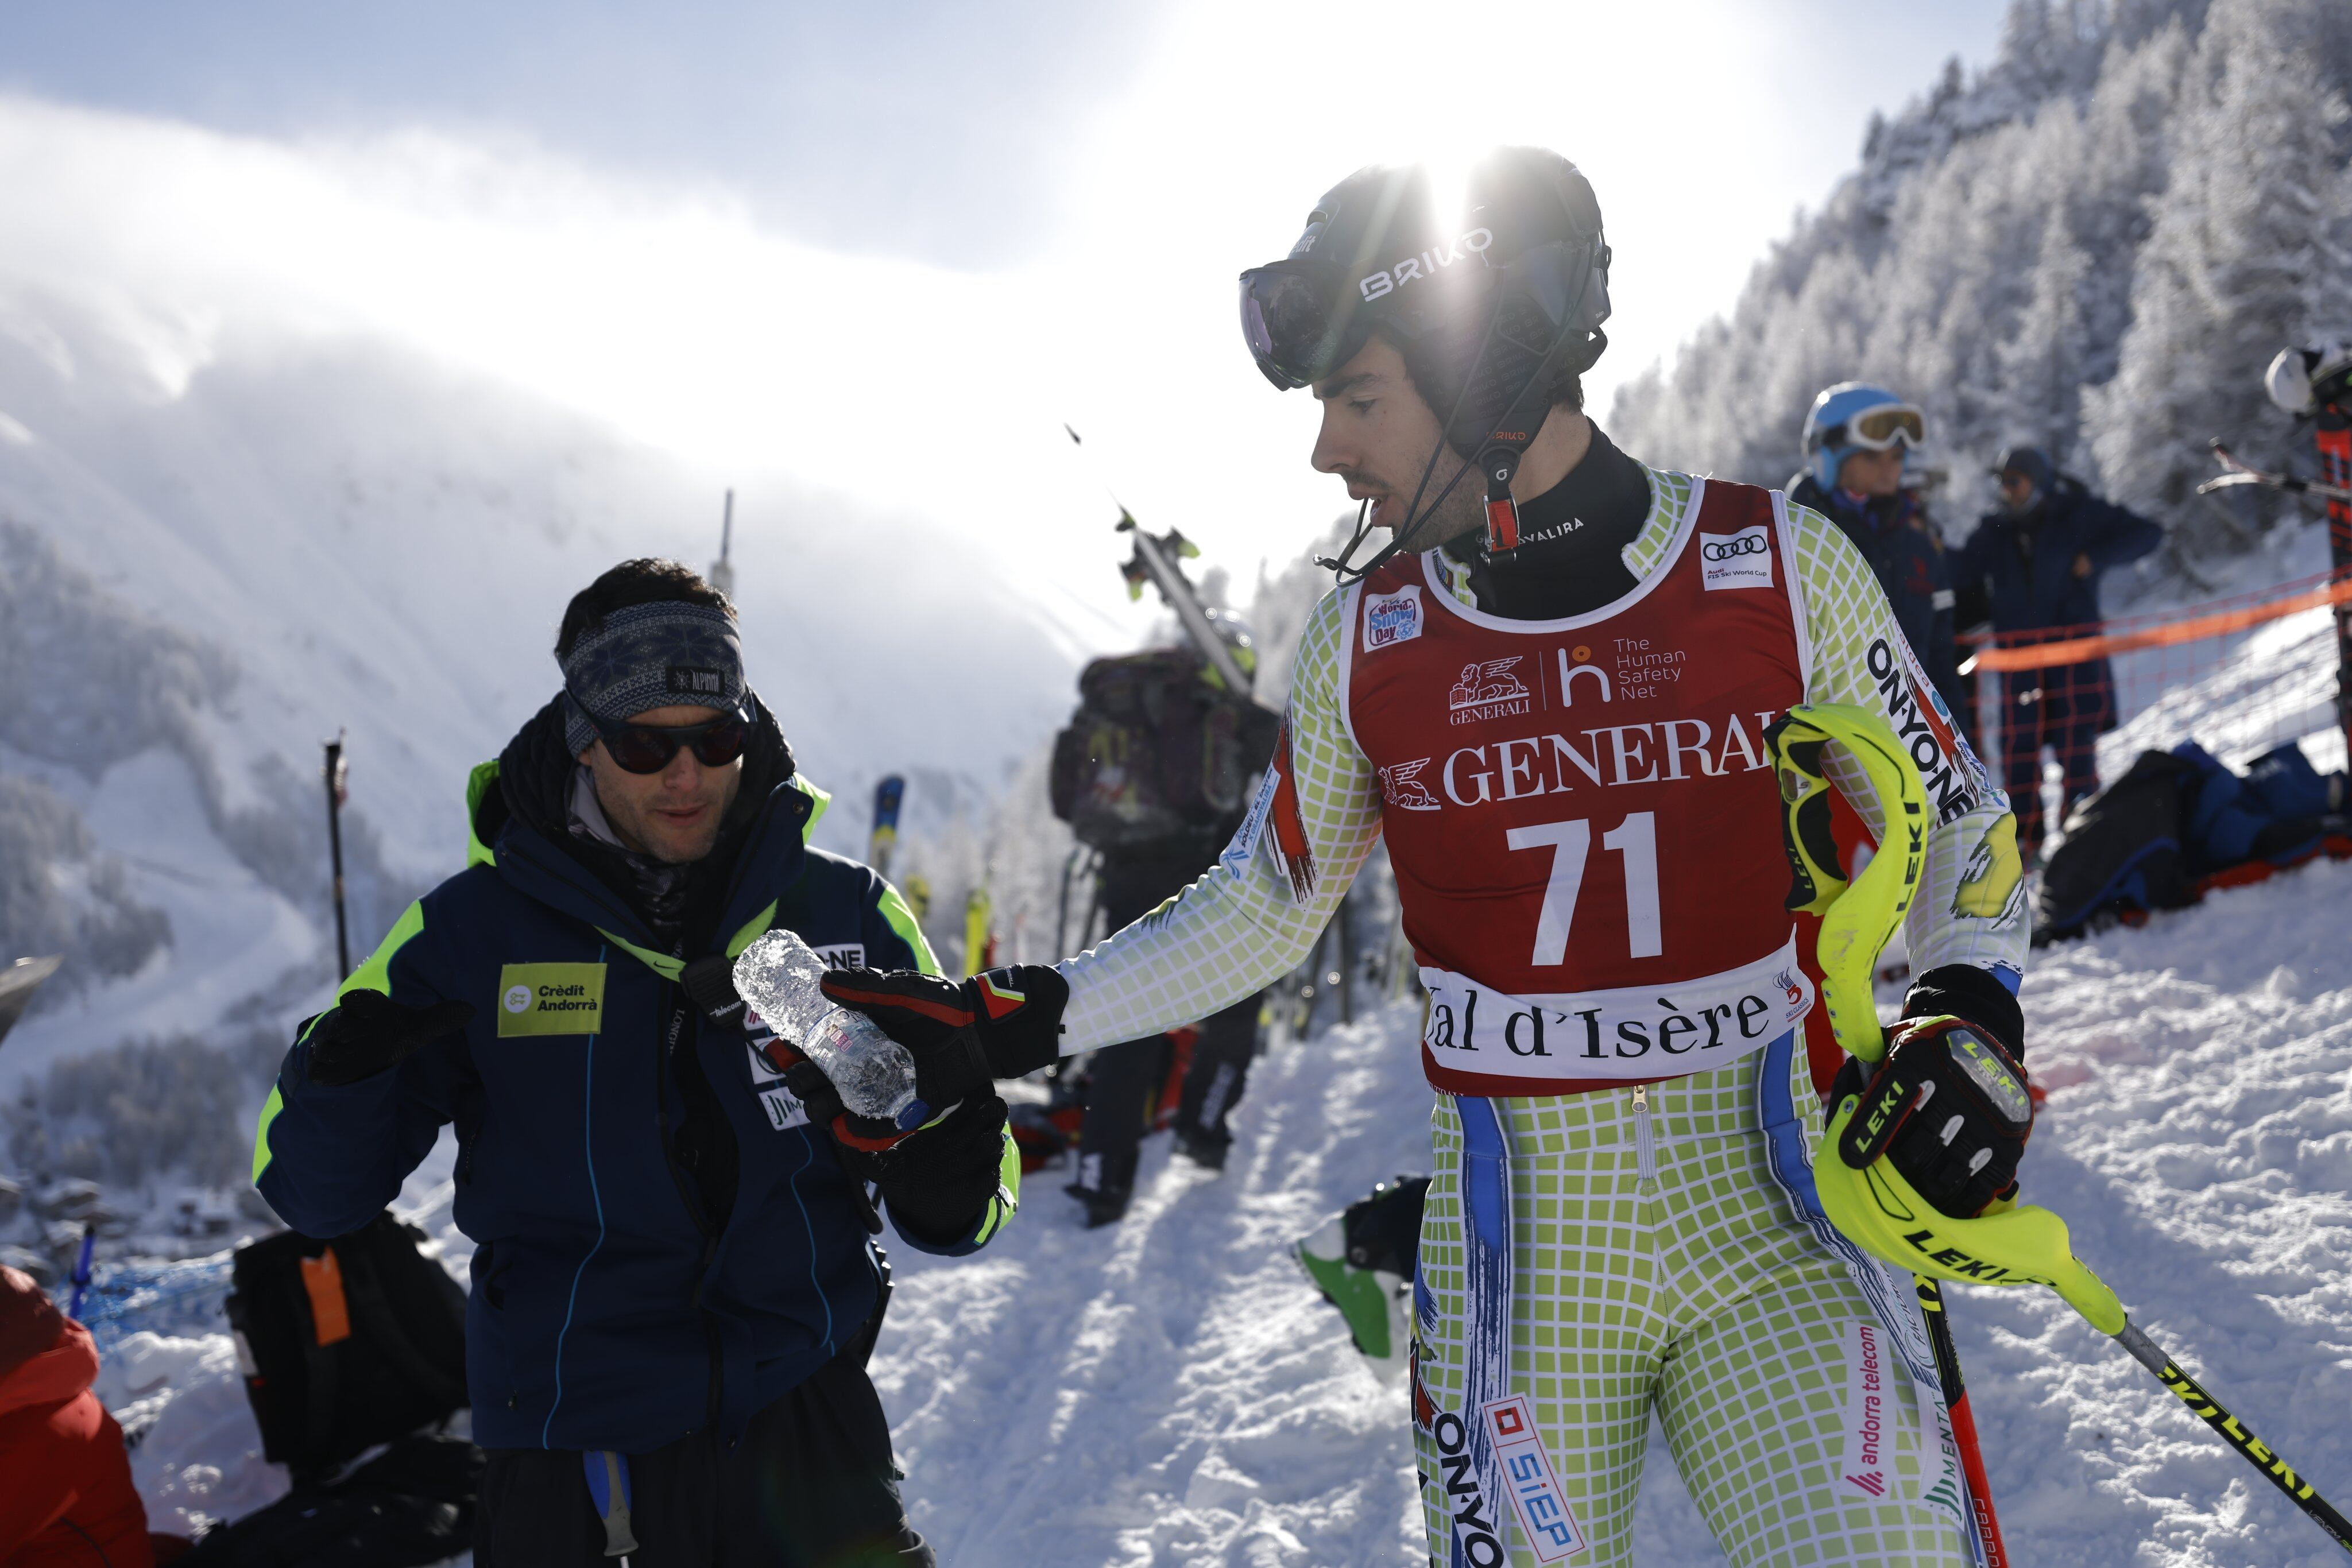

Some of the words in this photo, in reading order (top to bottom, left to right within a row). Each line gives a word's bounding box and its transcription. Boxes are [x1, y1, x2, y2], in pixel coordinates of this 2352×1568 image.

[1360, 227, 1493, 302] BRIKO
[1370, 609, 1414, 630] Snow
[1375, 626, 1396, 643] Day
[1613, 638, 1650, 653] The
[1616, 650, 1686, 669] Human
[1618, 667, 1681, 684] Safety
[1621, 685, 1657, 700] Net
[1450, 699, 1531, 726] GENERALI
[1443, 708, 1791, 807] GENERA
[1241, 814, 1254, 848] SOLDEU
[1790, 847, 1813, 890] LEKI
[1896, 802, 1922, 913] LEKI
[1506, 811, 1662, 966] 71
[537, 998, 597, 1011] Andorrà
[539, 985, 585, 997] Crèdit
[1786, 984, 1802, 1005] 5
[1962, 1043, 2027, 1107] LEKI
[1855, 1080, 1904, 1155] LEKI
[1903, 1229, 2011, 1281] LEKI
[1860, 1326, 1879, 1391] telecom
[1859, 1393, 1881, 1465] andorra
[2221, 1415, 2315, 1500] LEKI
